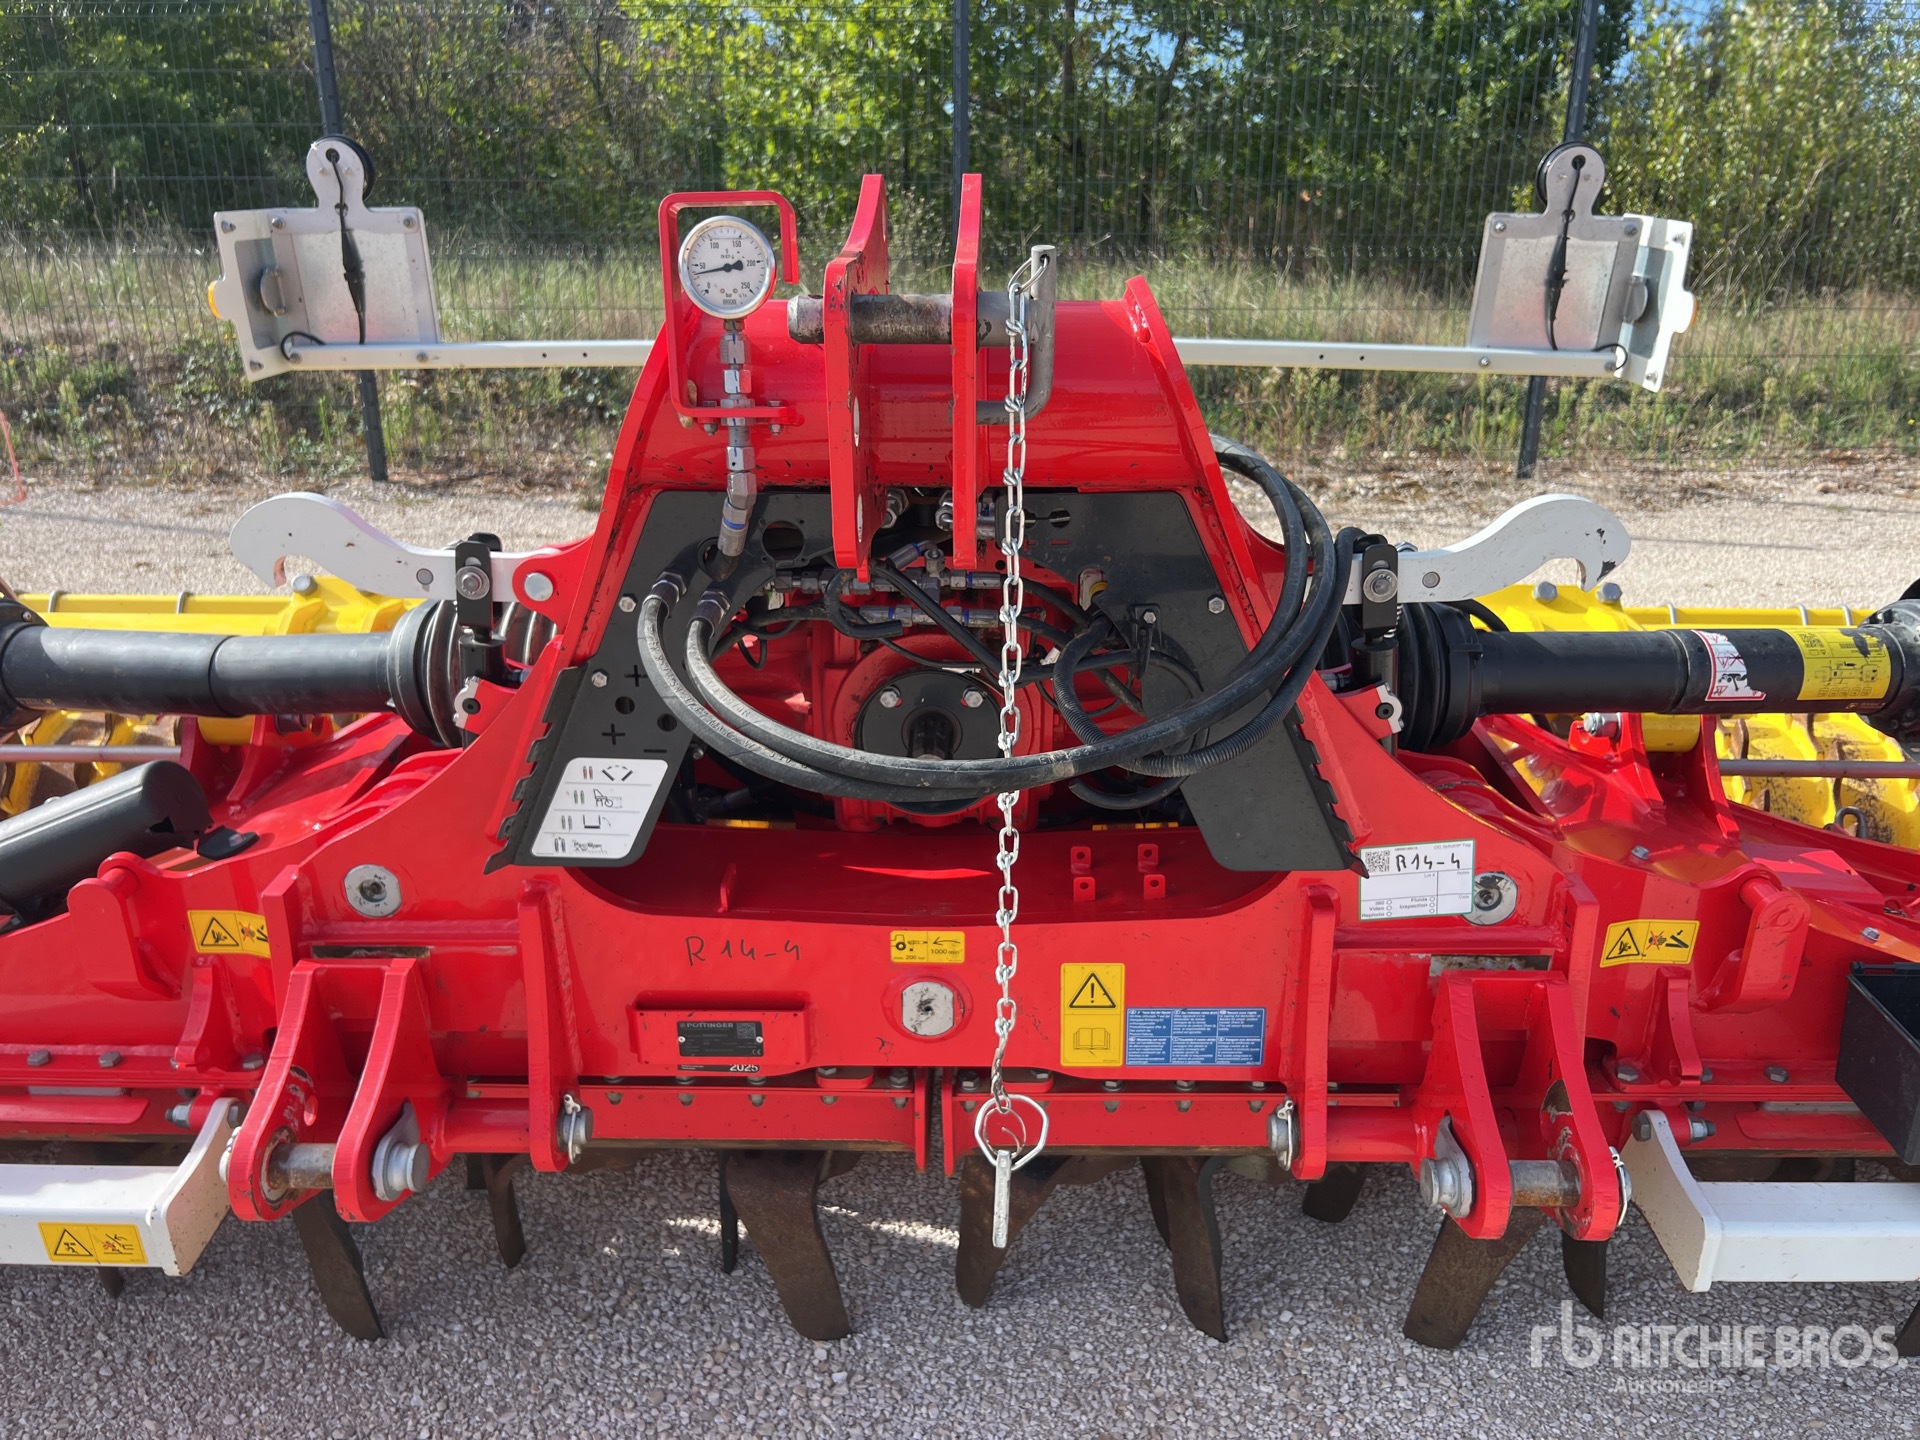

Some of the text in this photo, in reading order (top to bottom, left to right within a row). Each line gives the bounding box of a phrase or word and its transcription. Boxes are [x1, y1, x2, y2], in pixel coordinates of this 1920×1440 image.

[732, 240, 742, 248] 150
[699, 262, 706, 270] 50
[746, 259, 756, 267] 200
[707, 281, 711, 289] 0
[741, 281, 751, 289] 250
[729, 1064, 759, 1073] 2025
